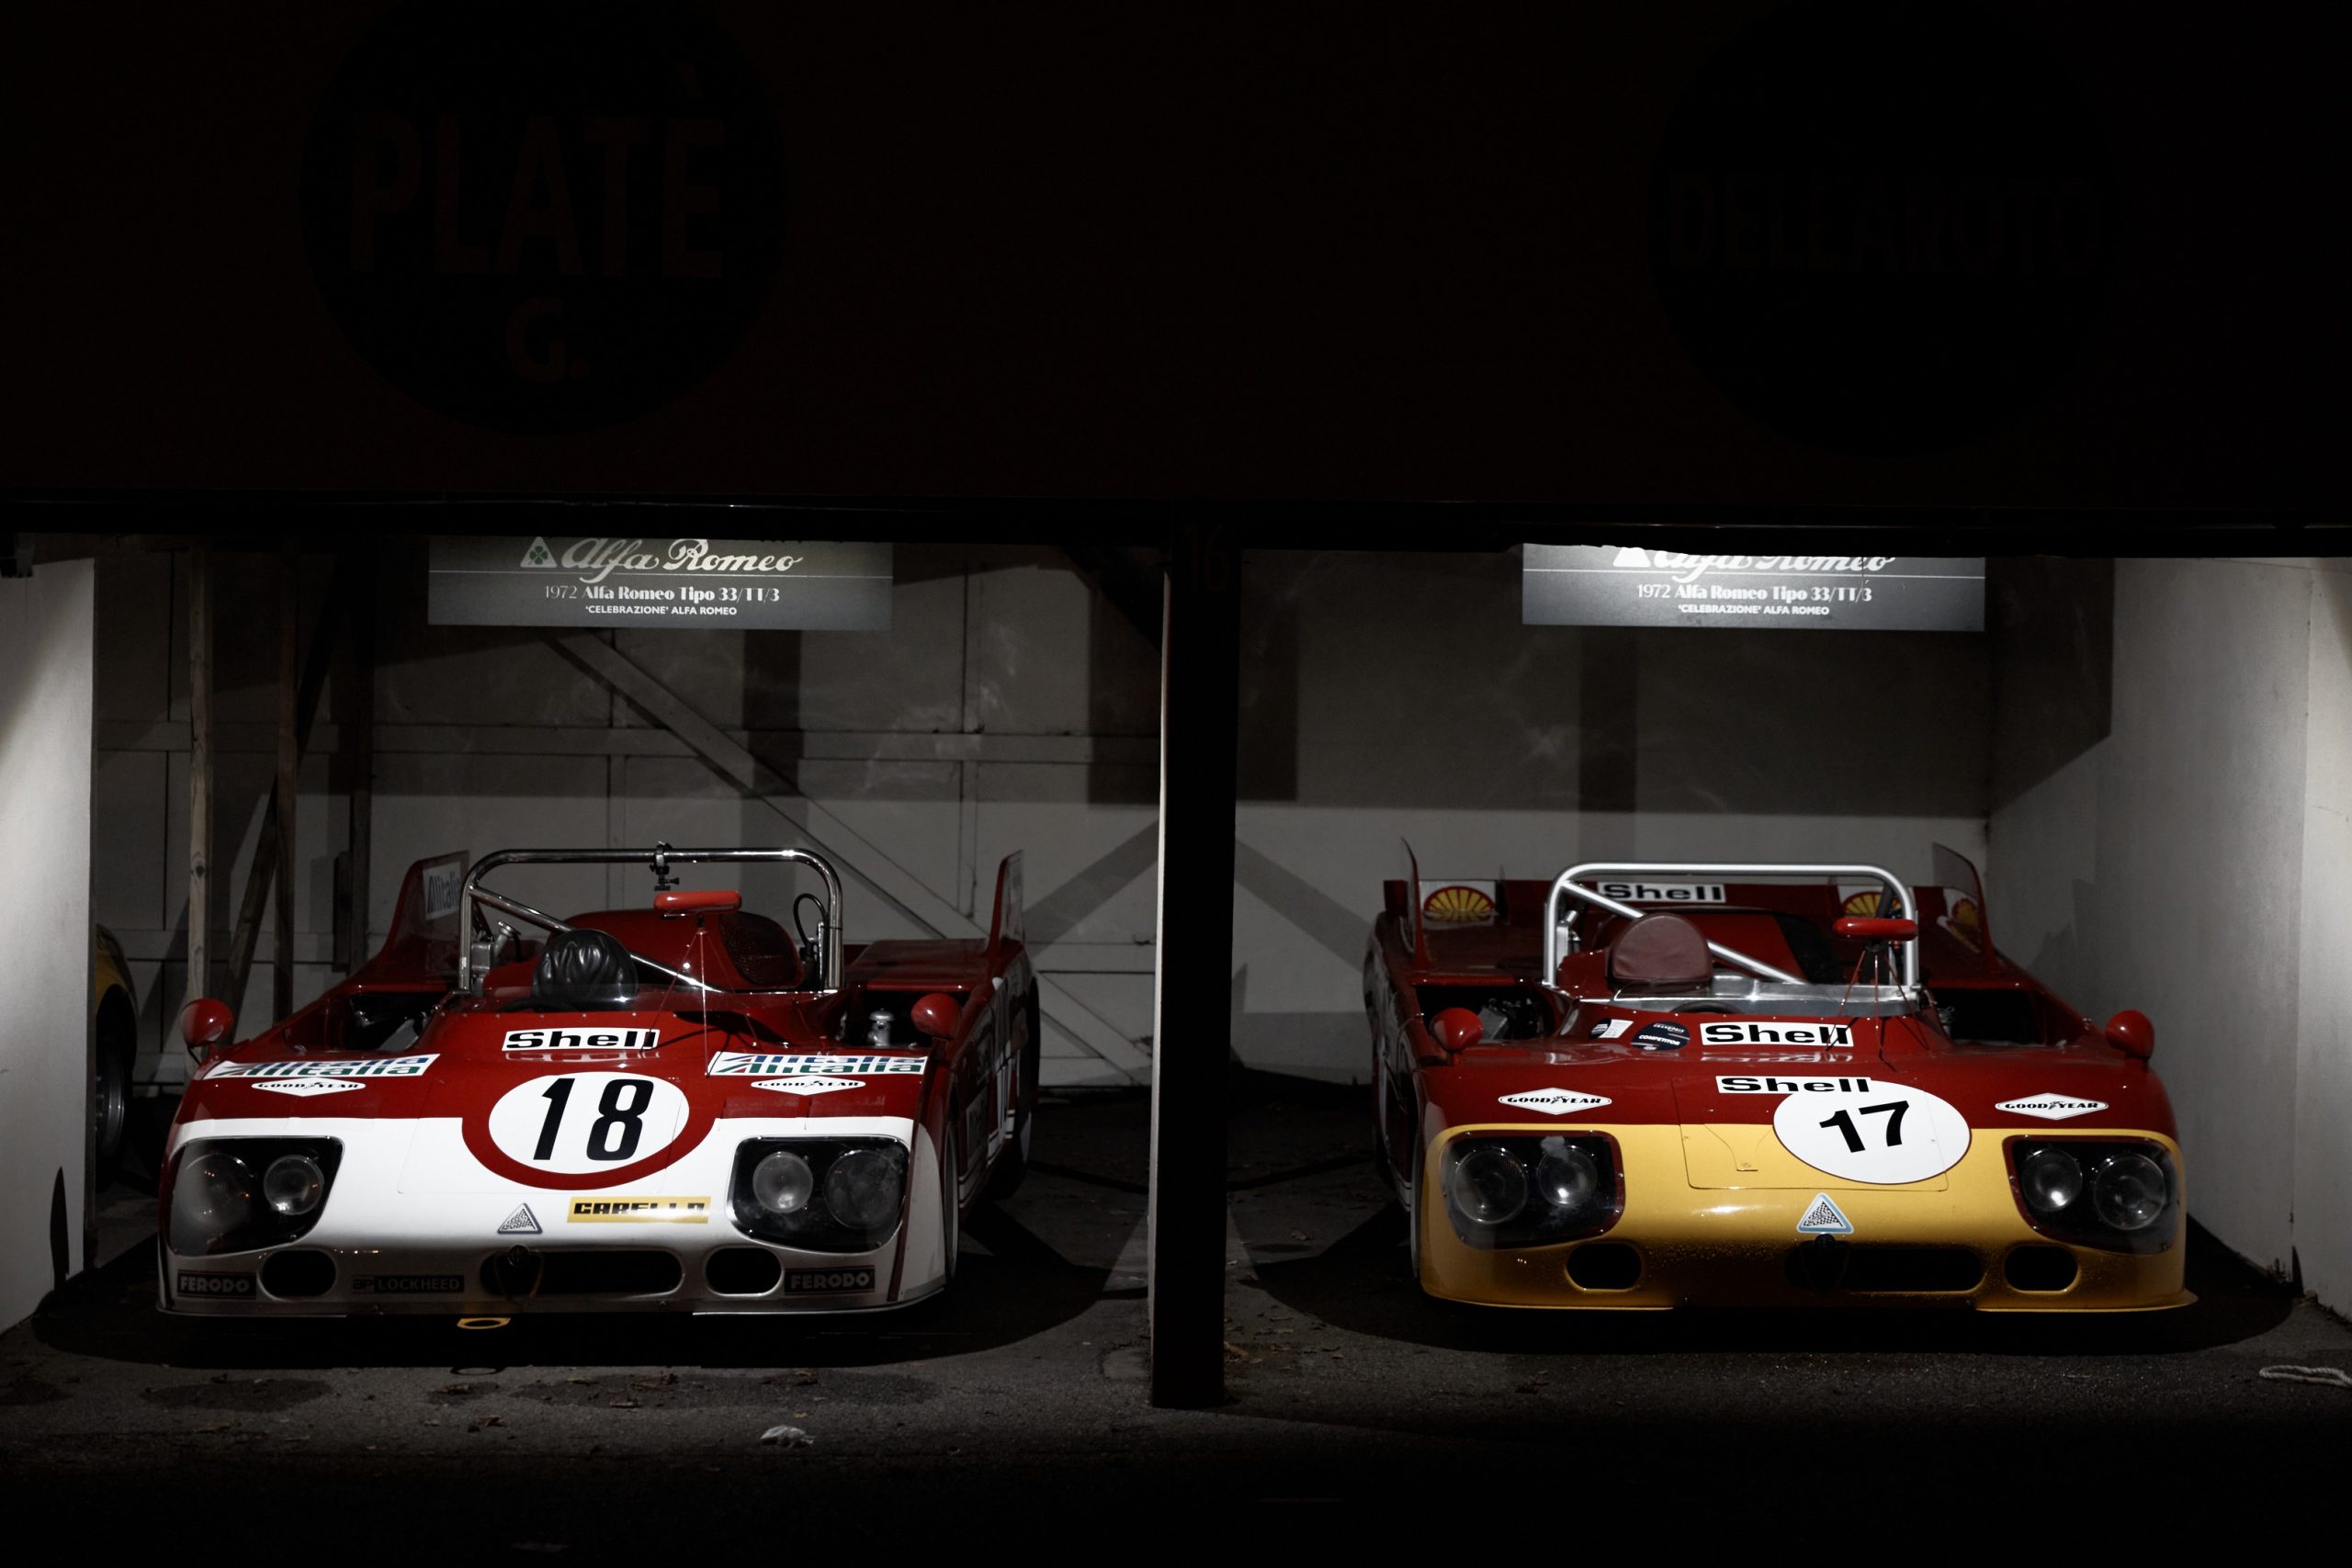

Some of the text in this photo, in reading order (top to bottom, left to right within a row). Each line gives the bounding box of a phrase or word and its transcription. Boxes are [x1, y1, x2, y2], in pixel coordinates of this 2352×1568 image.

[351, 61, 725, 277] PLATÈ
[560, 537, 804, 583] Alfa Romeo
[545, 585, 780, 604] 1972 Alfa Romeo Tipo 33/TT/3
[1637, 584, 1872, 604] 1972 Alfa Romeo Tipo 33/TT/3
[671, 606, 697, 615] ALFA
[700, 606, 738, 616] ROMEO
[1763, 604, 1790, 615] ALFA
[1792, 605, 1830, 615] ROMEO
[1603, 883, 1722, 902] Shell
[507, 1030, 658, 1049] Shell
[1705, 1024, 1849, 1045] Shell
[1722, 1077, 1870, 1093] Shell
[533, 1077, 653, 1161] 18
[1819, 1100, 1909, 1153] 17
[180, 1276, 250, 1293] FERODO
[378, 1278, 460, 1291] LOCKHEED
[790, 1271, 870, 1290] FERODO
